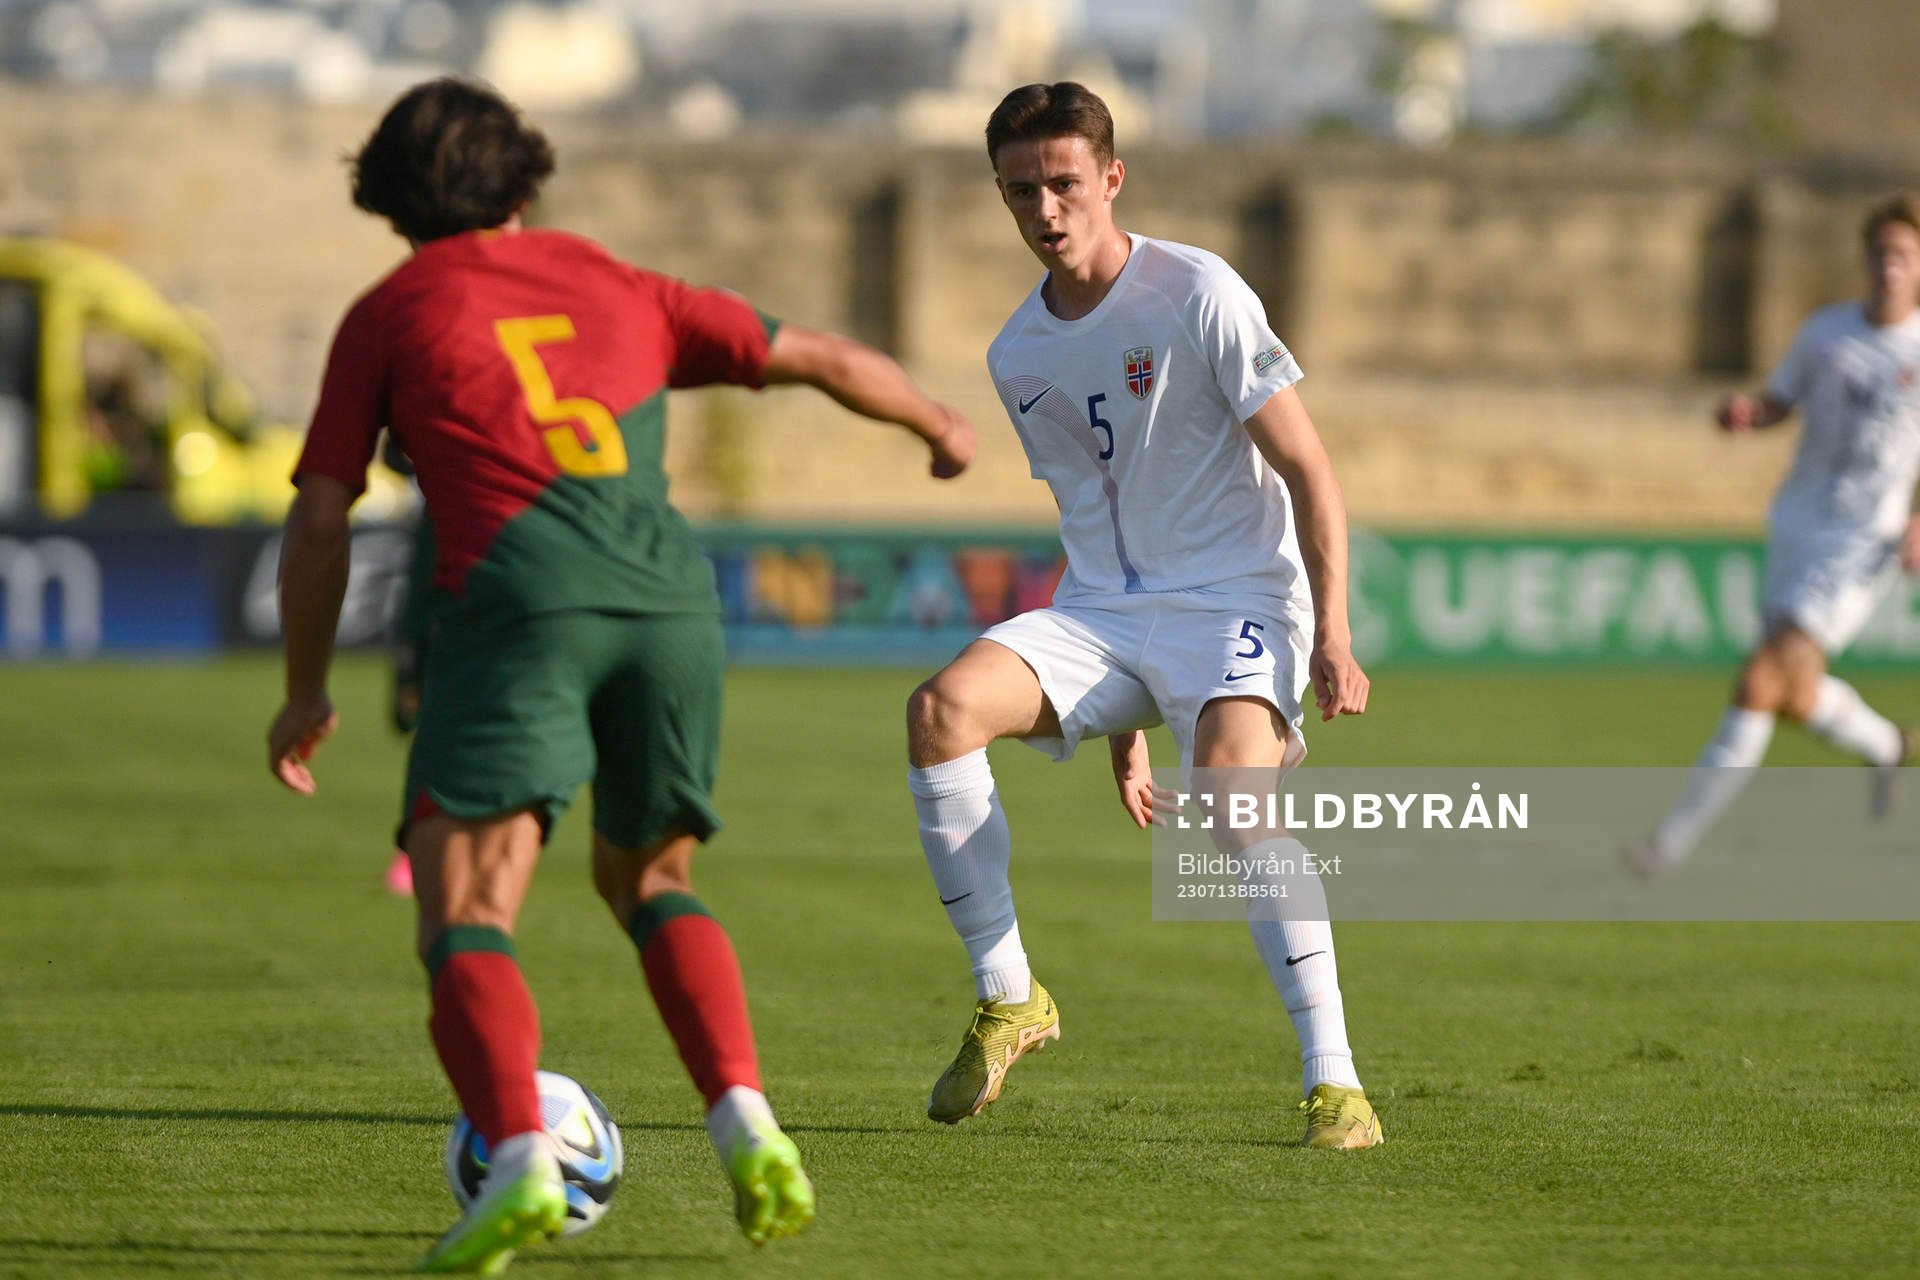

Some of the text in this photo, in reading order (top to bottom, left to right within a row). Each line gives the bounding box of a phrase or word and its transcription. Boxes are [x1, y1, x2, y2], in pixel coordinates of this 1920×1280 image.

[493, 313, 629, 478] 5
[1087, 392, 1115, 461] 5
[1235, 620, 1265, 659] 5
